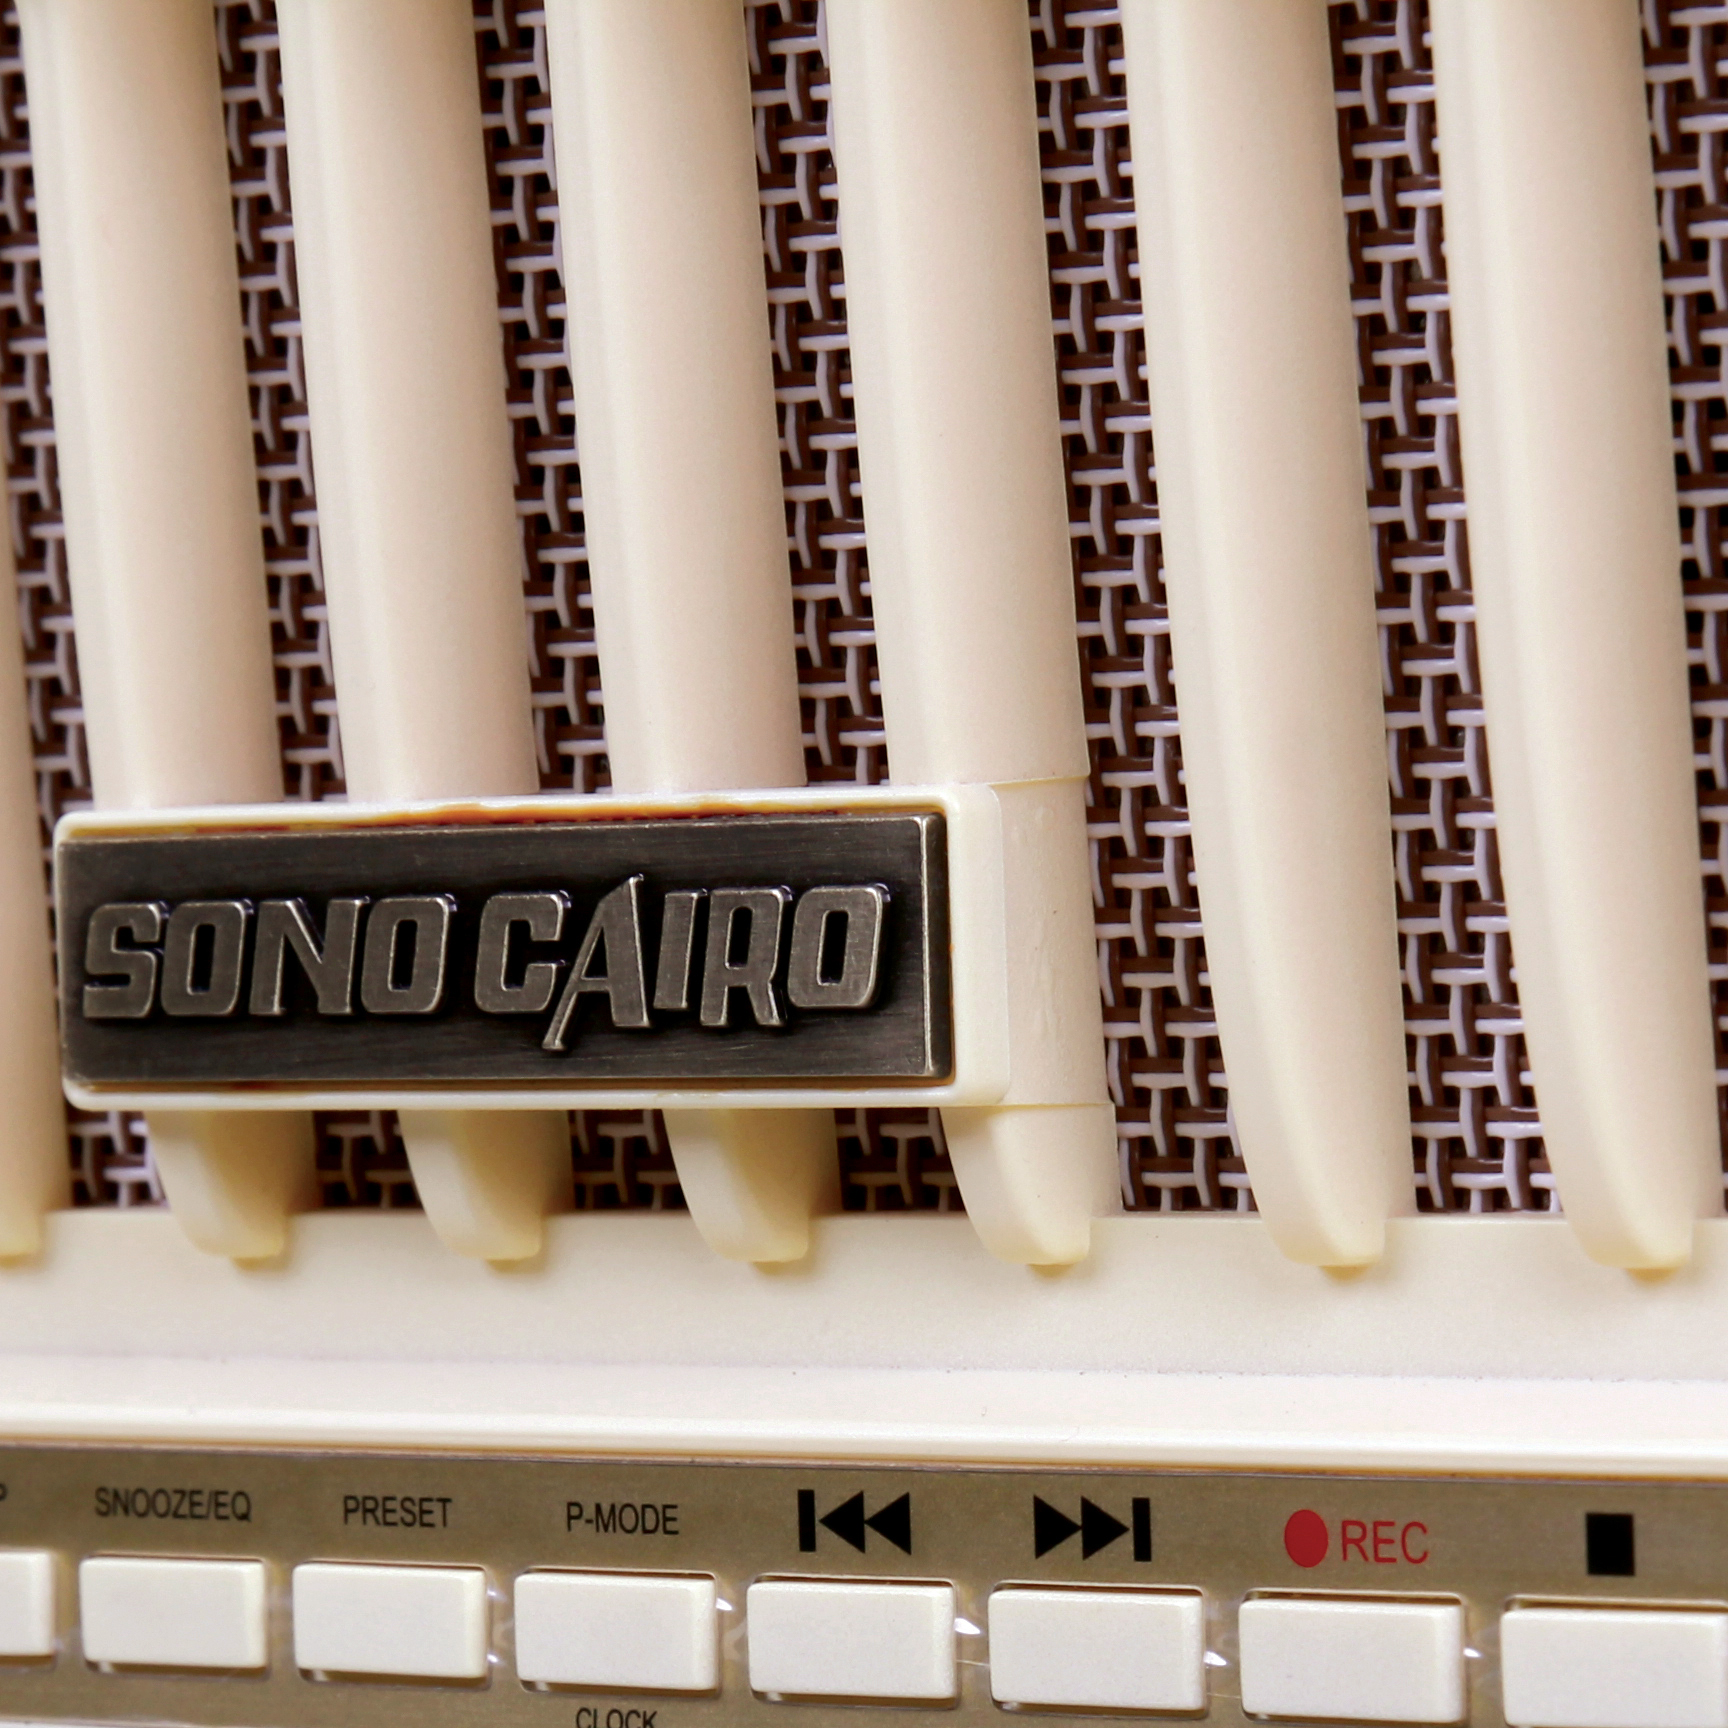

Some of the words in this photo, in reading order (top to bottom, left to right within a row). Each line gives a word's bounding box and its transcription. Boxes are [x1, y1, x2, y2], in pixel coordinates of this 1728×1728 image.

[82, 892, 459, 1020] SONO
[473, 872, 891, 1053] CAIRO
[93, 1487, 253, 1524] SNOOZE/EQ
[342, 1494, 454, 1530] PRESET
[565, 1501, 680, 1537] P-MODE
[1341, 1519, 1431, 1566] REC
